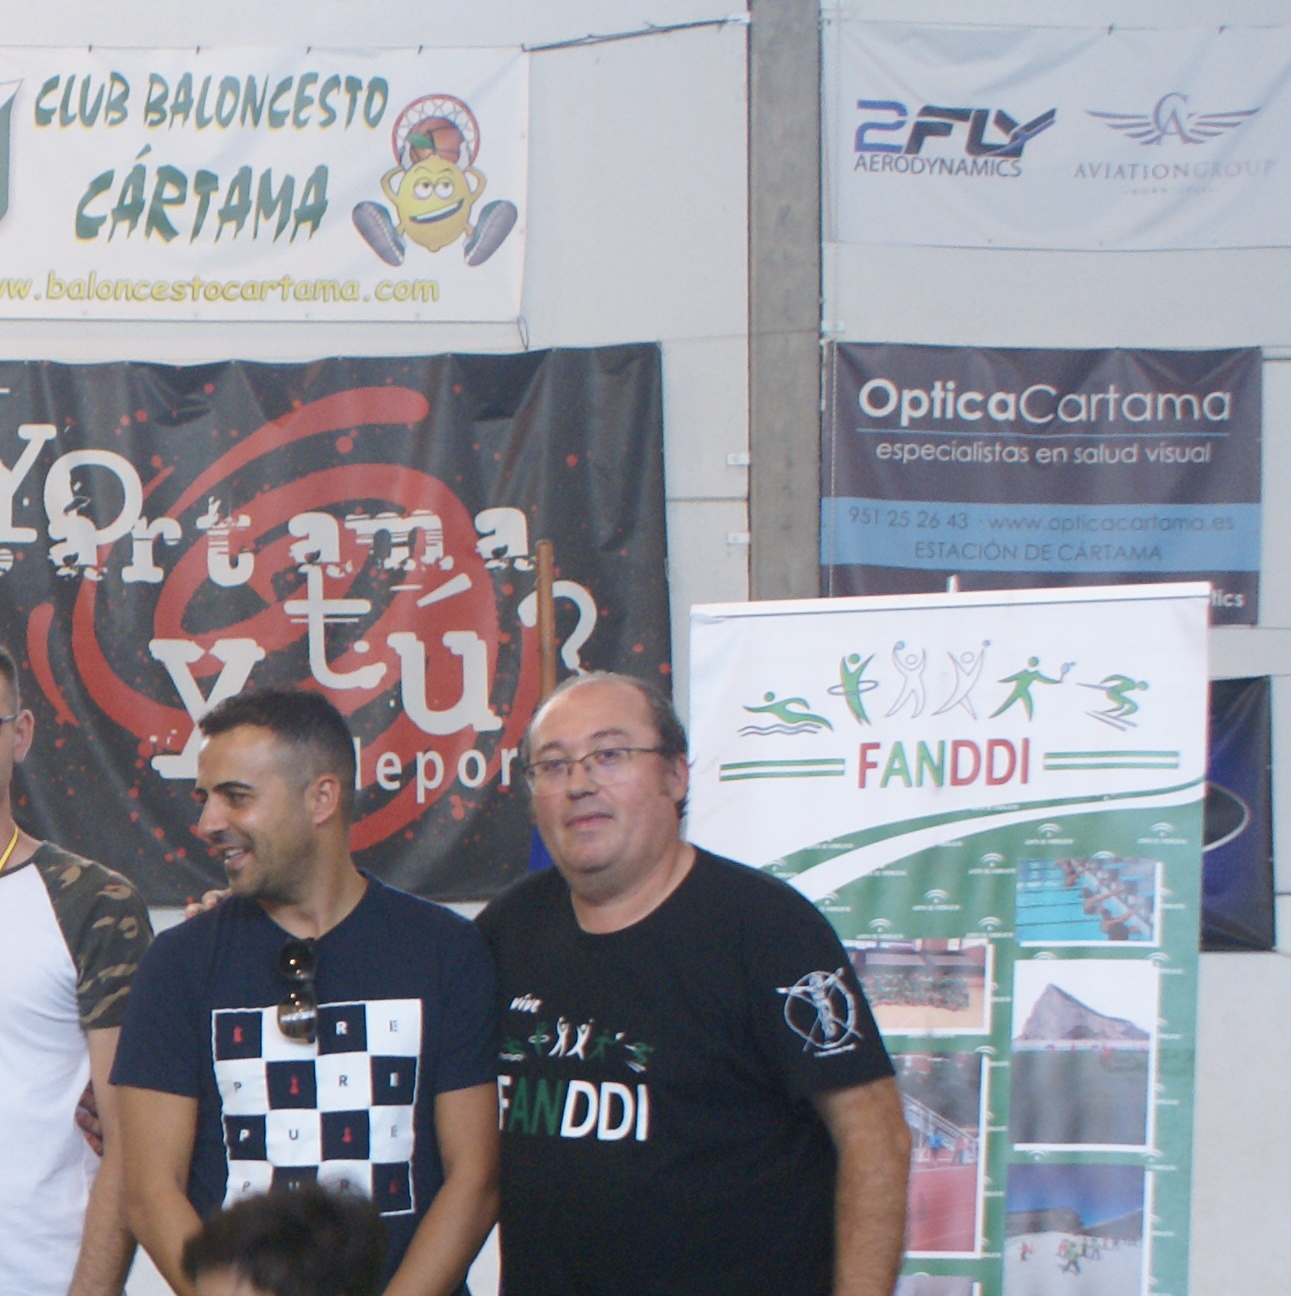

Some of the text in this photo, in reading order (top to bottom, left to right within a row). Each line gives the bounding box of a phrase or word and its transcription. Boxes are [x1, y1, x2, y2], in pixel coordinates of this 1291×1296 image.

[33, 71, 390, 133] CLUB BALONCESTO
[854, 100, 1058, 159] 2FLY
[853, 154, 1023, 178] AERODYNAMICS
[74, 143, 330, 245] CÁRTAMA
[858, 377, 1233, 427] OpticaCartama
[875, 440, 1213, 465] especialistas en salud visual
[848, 506, 1236, 538] 951 25 26 43 www.opticacartama.es
[914, 536, 1164, 564] ESTACIÓN DE CÁRTAMA
[857, 738, 1030, 789] FANDDI
